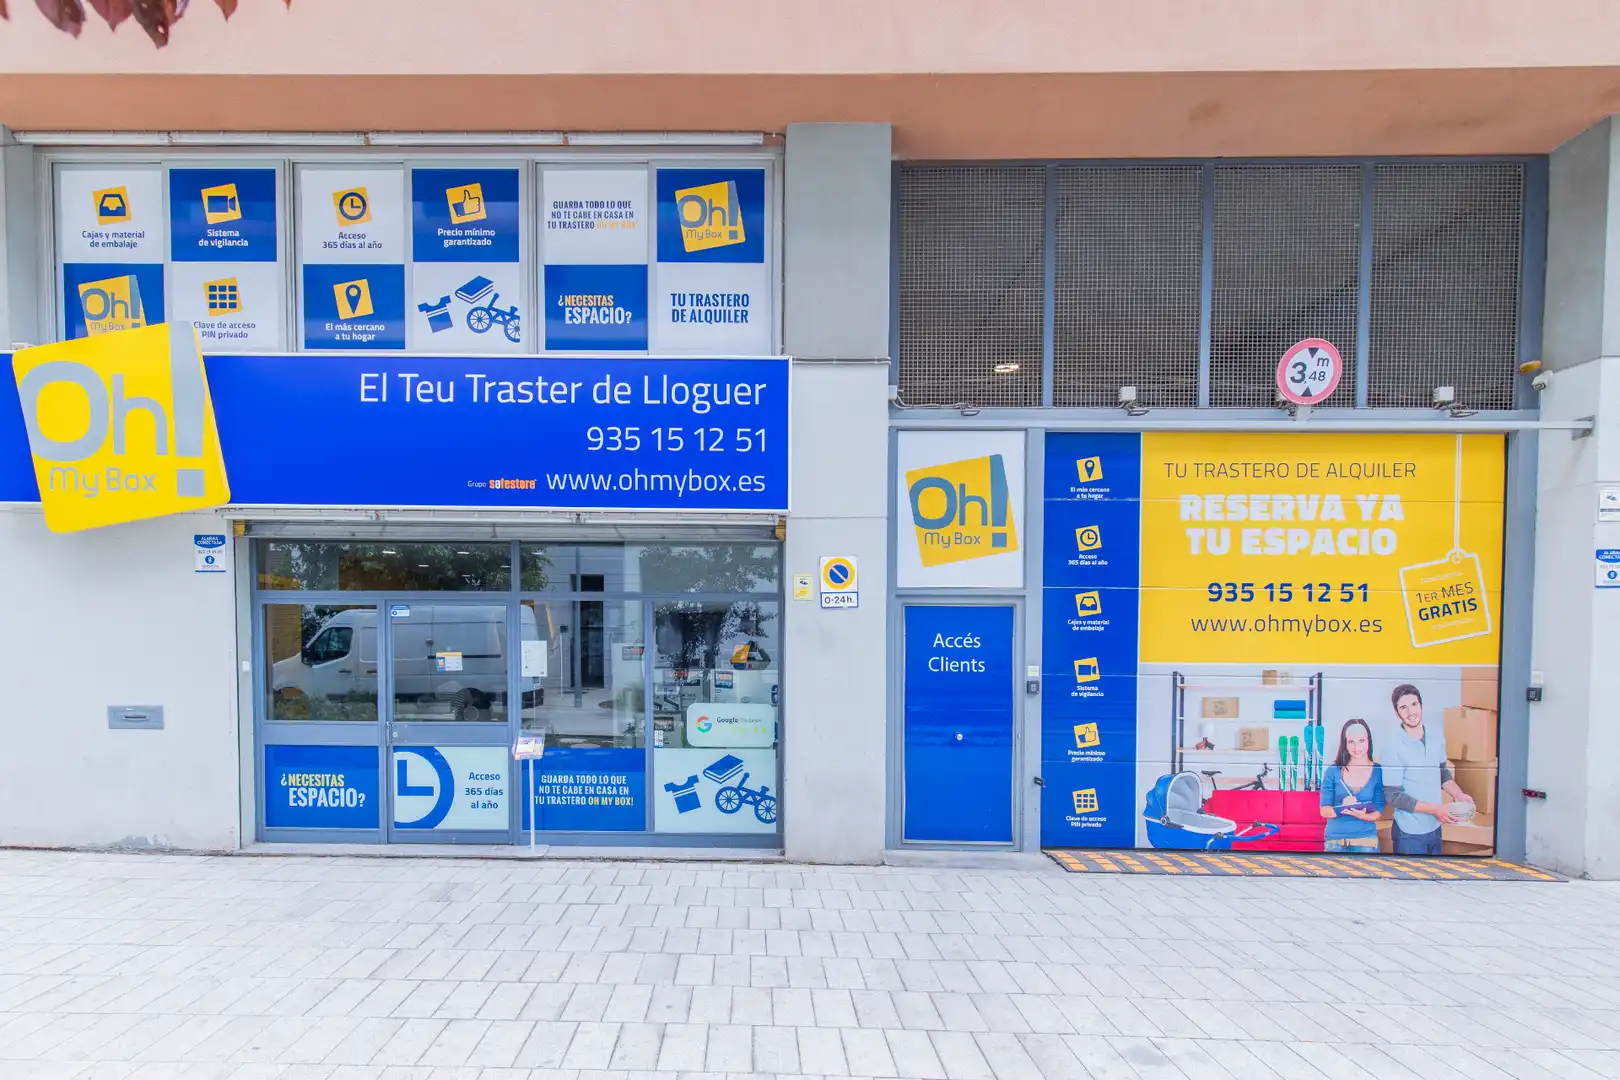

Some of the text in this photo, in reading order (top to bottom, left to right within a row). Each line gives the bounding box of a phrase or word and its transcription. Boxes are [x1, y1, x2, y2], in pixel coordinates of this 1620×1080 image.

[553, 201, 583, 209] GUARDA
[617, 201, 631, 209] QUE
[677, 180, 738, 240] Oh!
[552, 211, 561, 219] NO
[564, 211, 571, 219] TE
[573, 211, 591, 219] CABE
[594, 211, 602, 219] EN
[604, 211, 623, 219] CASA
[548, 221, 556, 229] TU
[559, 221, 594, 229] TRASTERO
[82, 230, 145, 240] Cajas y material
[207, 229, 240, 237] Sistema
[438, 228, 495, 236] Precio mínimo
[687, 228, 722, 241] My Box
[101, 240, 137, 249] embalaje
[199, 238, 248, 247] de vigilancia
[323, 240, 382, 249] 365 días al año
[444, 237, 492, 248] garantizado
[558, 295, 614, 307] ¿NECESITAS
[670, 294, 749, 307] TU TRASTERO
[565, 307, 632, 325] ESPACIO?
[672, 309, 749, 324] DE ALQUILER
[90, 321, 125, 333] My Box
[194, 321, 210, 329] Clave
[213, 321, 223, 329] de
[325, 323, 333, 331] El
[335, 323, 351, 331] más
[218, 330, 248, 340] privado
[352, 332, 376, 342] hogar
[1317, 357, 1329, 367] m
[360, 373, 766, 414] El Teu Traster de Lloguer
[19, 321, 205, 497] Oh!
[587, 427, 766, 452] 935 15 12 51
[1164, 463, 1416, 480] TU TRASTERO DE ALQUILER
[50, 466, 157, 498] My Box
[489, 478, 535, 489] safestore
[546, 469, 766, 497] www.ohmybox.es
[909, 454, 1009, 548] Oh!
[1180, 494, 1404, 521] RESERVA YA
[924, 532, 981, 548] My Box
[1186, 529, 1396, 555] TU ESPACIO
[1208, 583, 1369, 603] 935 15 12 51
[1441, 582, 1474, 600] MES
[1419, 598, 1478, 622] GRATIS
[1191, 614, 1382, 637] www.ohmybox.es
[933, 633, 981, 648] Accés
[928, 657, 985, 672] Clients
[281, 774, 344, 786] ¿NECESITAS
[468, 772, 500, 781] Acceso
[541, 775, 626, 784] GUARDA TODO LO QUE
[465, 786, 503, 796] 365 días
[539, 786, 550, 794] NO
[552, 786, 560, 794] TE
[563, 786, 583, 794] CABE
[585, 786, 594, 794] EN
[596, 786, 617, 794] CASA
[289, 787, 365, 807] ESPACIO?
[535, 796, 633, 805] TU TRASTERO OH MY BOX!
[471, 800, 498, 809] al año
